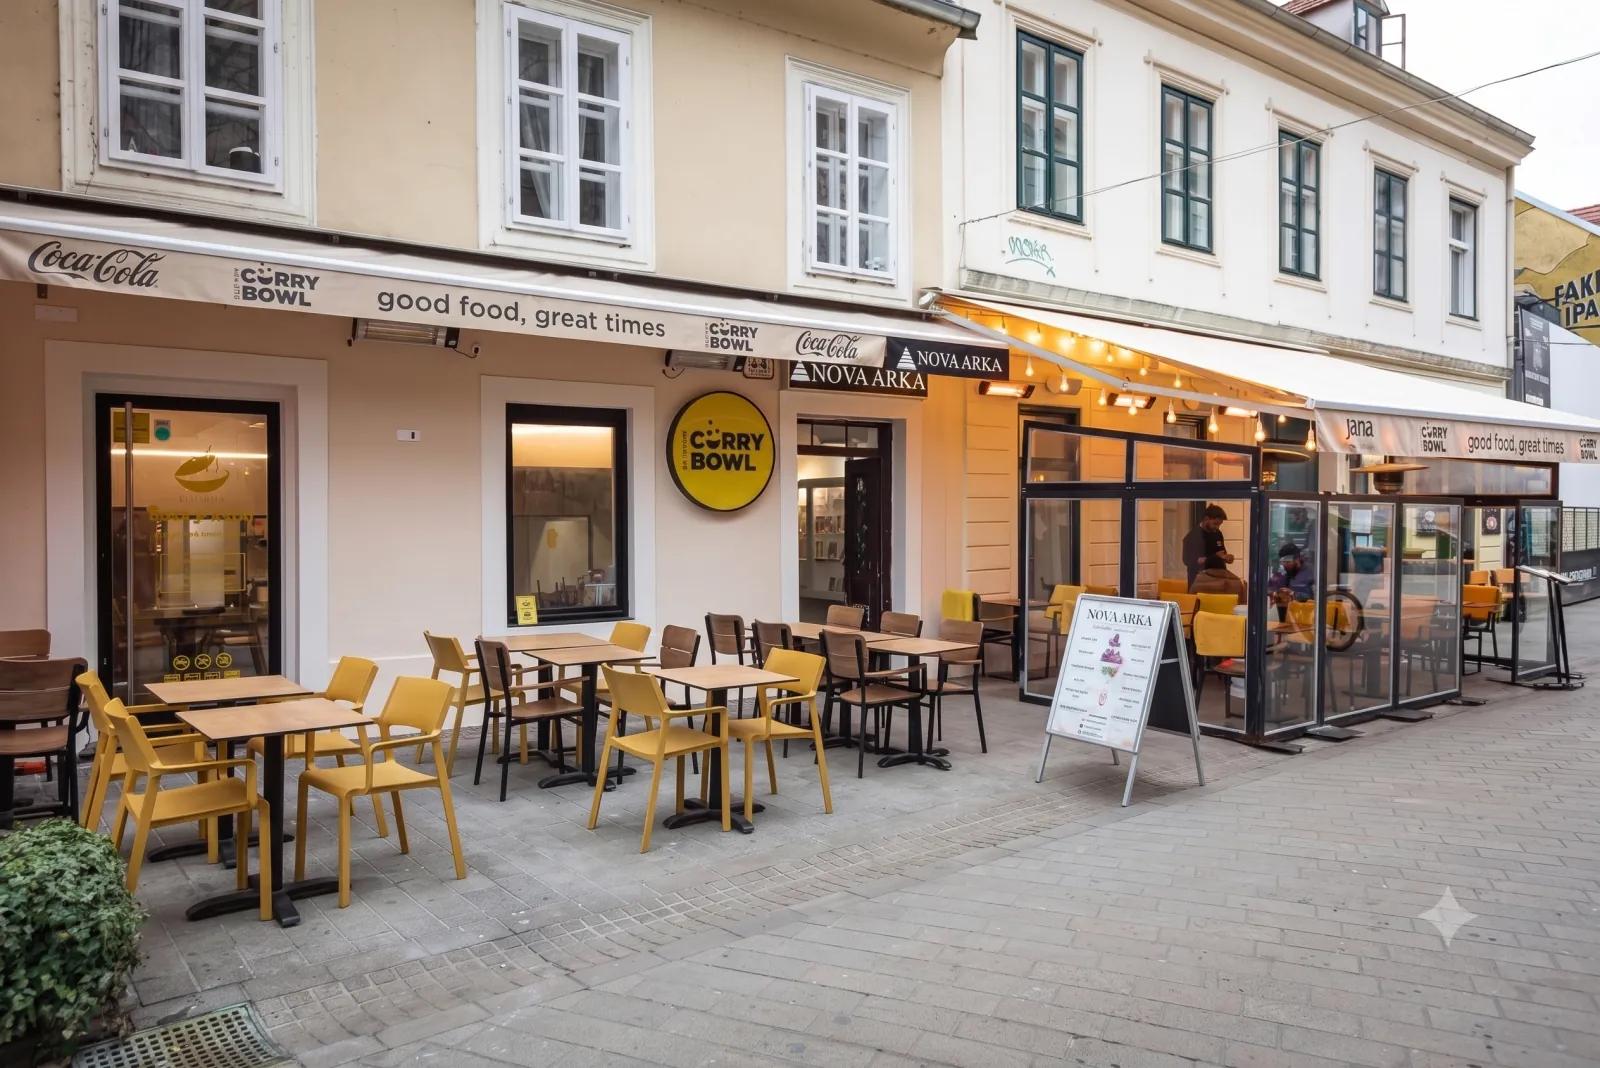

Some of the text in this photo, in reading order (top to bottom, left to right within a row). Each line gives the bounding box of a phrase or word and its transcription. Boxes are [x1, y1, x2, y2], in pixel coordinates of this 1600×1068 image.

[28, 241, 166, 287] Coca-Cola
[241, 266, 320, 290] CURRY
[242, 285, 312, 307] BOWL
[377, 291, 666, 337] good food, great times
[1566, 299, 1599, 327] IPA
[709, 320, 758, 339] CURRY
[710, 337, 753, 352] BOWL
[796, 331, 861, 359] Coca-Cola
[917, 350, 1003, 372] NOVA ARKA
[811, 363, 926, 391] NOVA ARKA
[690, 427, 764, 451] CURRY
[1423, 440, 1446, 453] BOWL
[1468, 433, 1564, 456] good food, great times
[691, 452, 756, 472] BOWL
[1581, 449, 1598, 460] BOWL
[1087, 608, 1152, 627] NOVA ARKA
